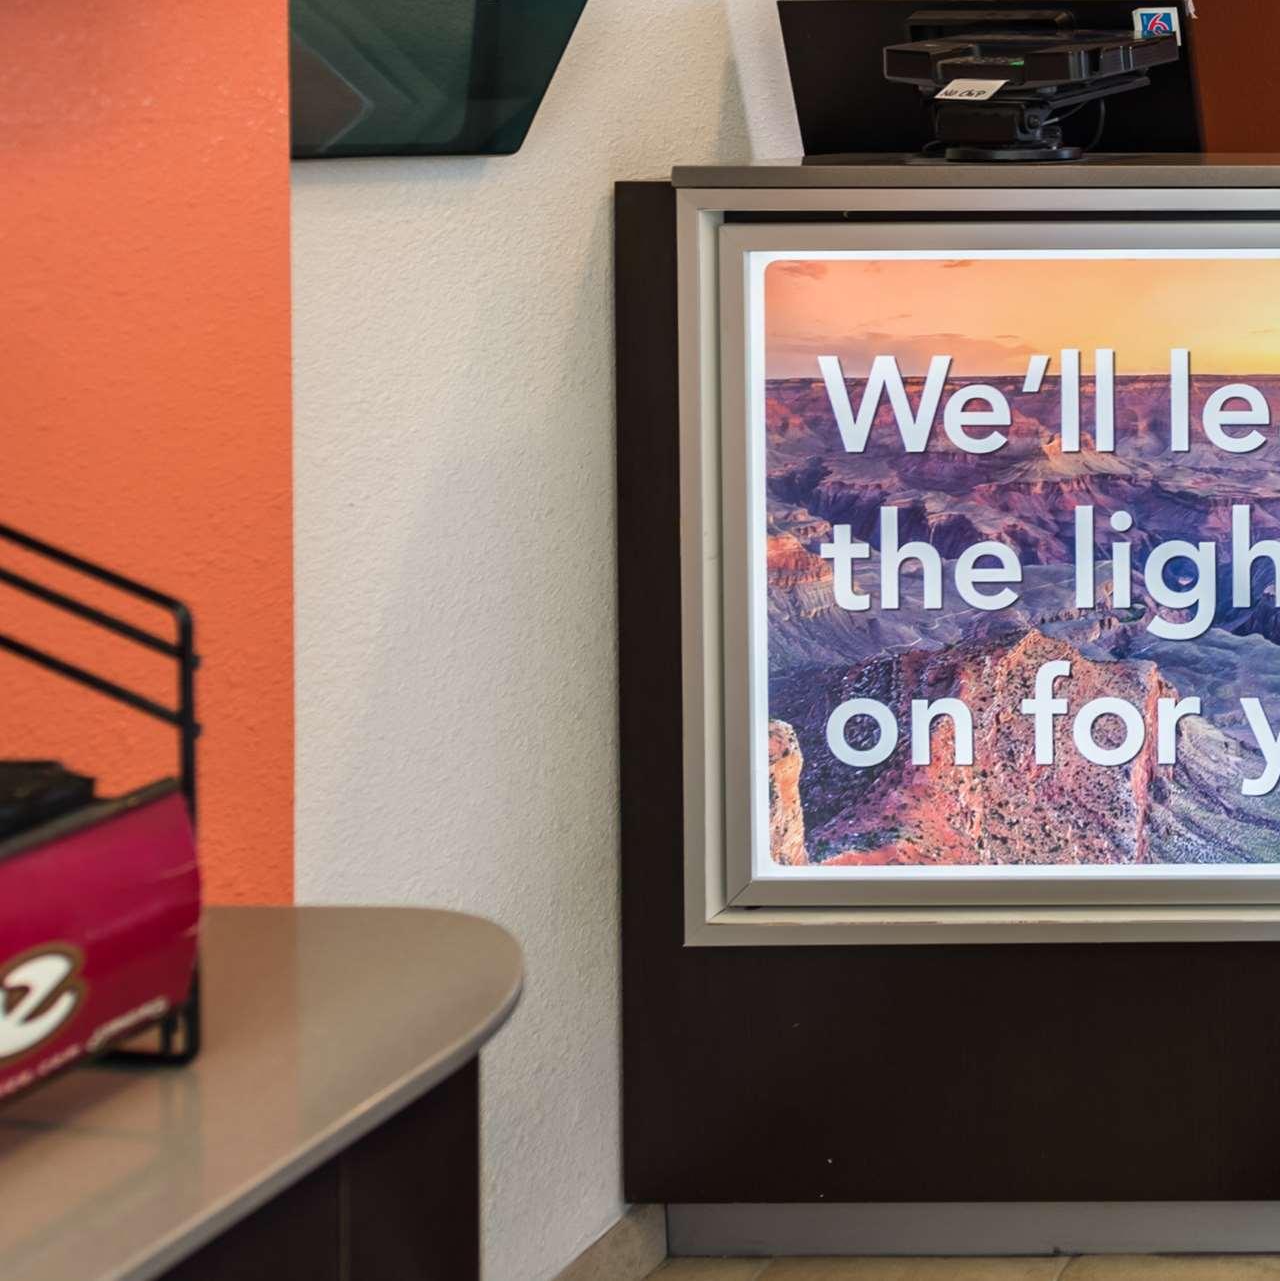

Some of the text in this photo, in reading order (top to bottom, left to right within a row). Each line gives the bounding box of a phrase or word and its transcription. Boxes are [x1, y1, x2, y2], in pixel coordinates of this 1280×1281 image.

[818, 348, 1116, 454] We'll
[820, 505, 1023, 612] the
[825, 694, 974, 768] on
[1022, 660, 1204, 767] for
